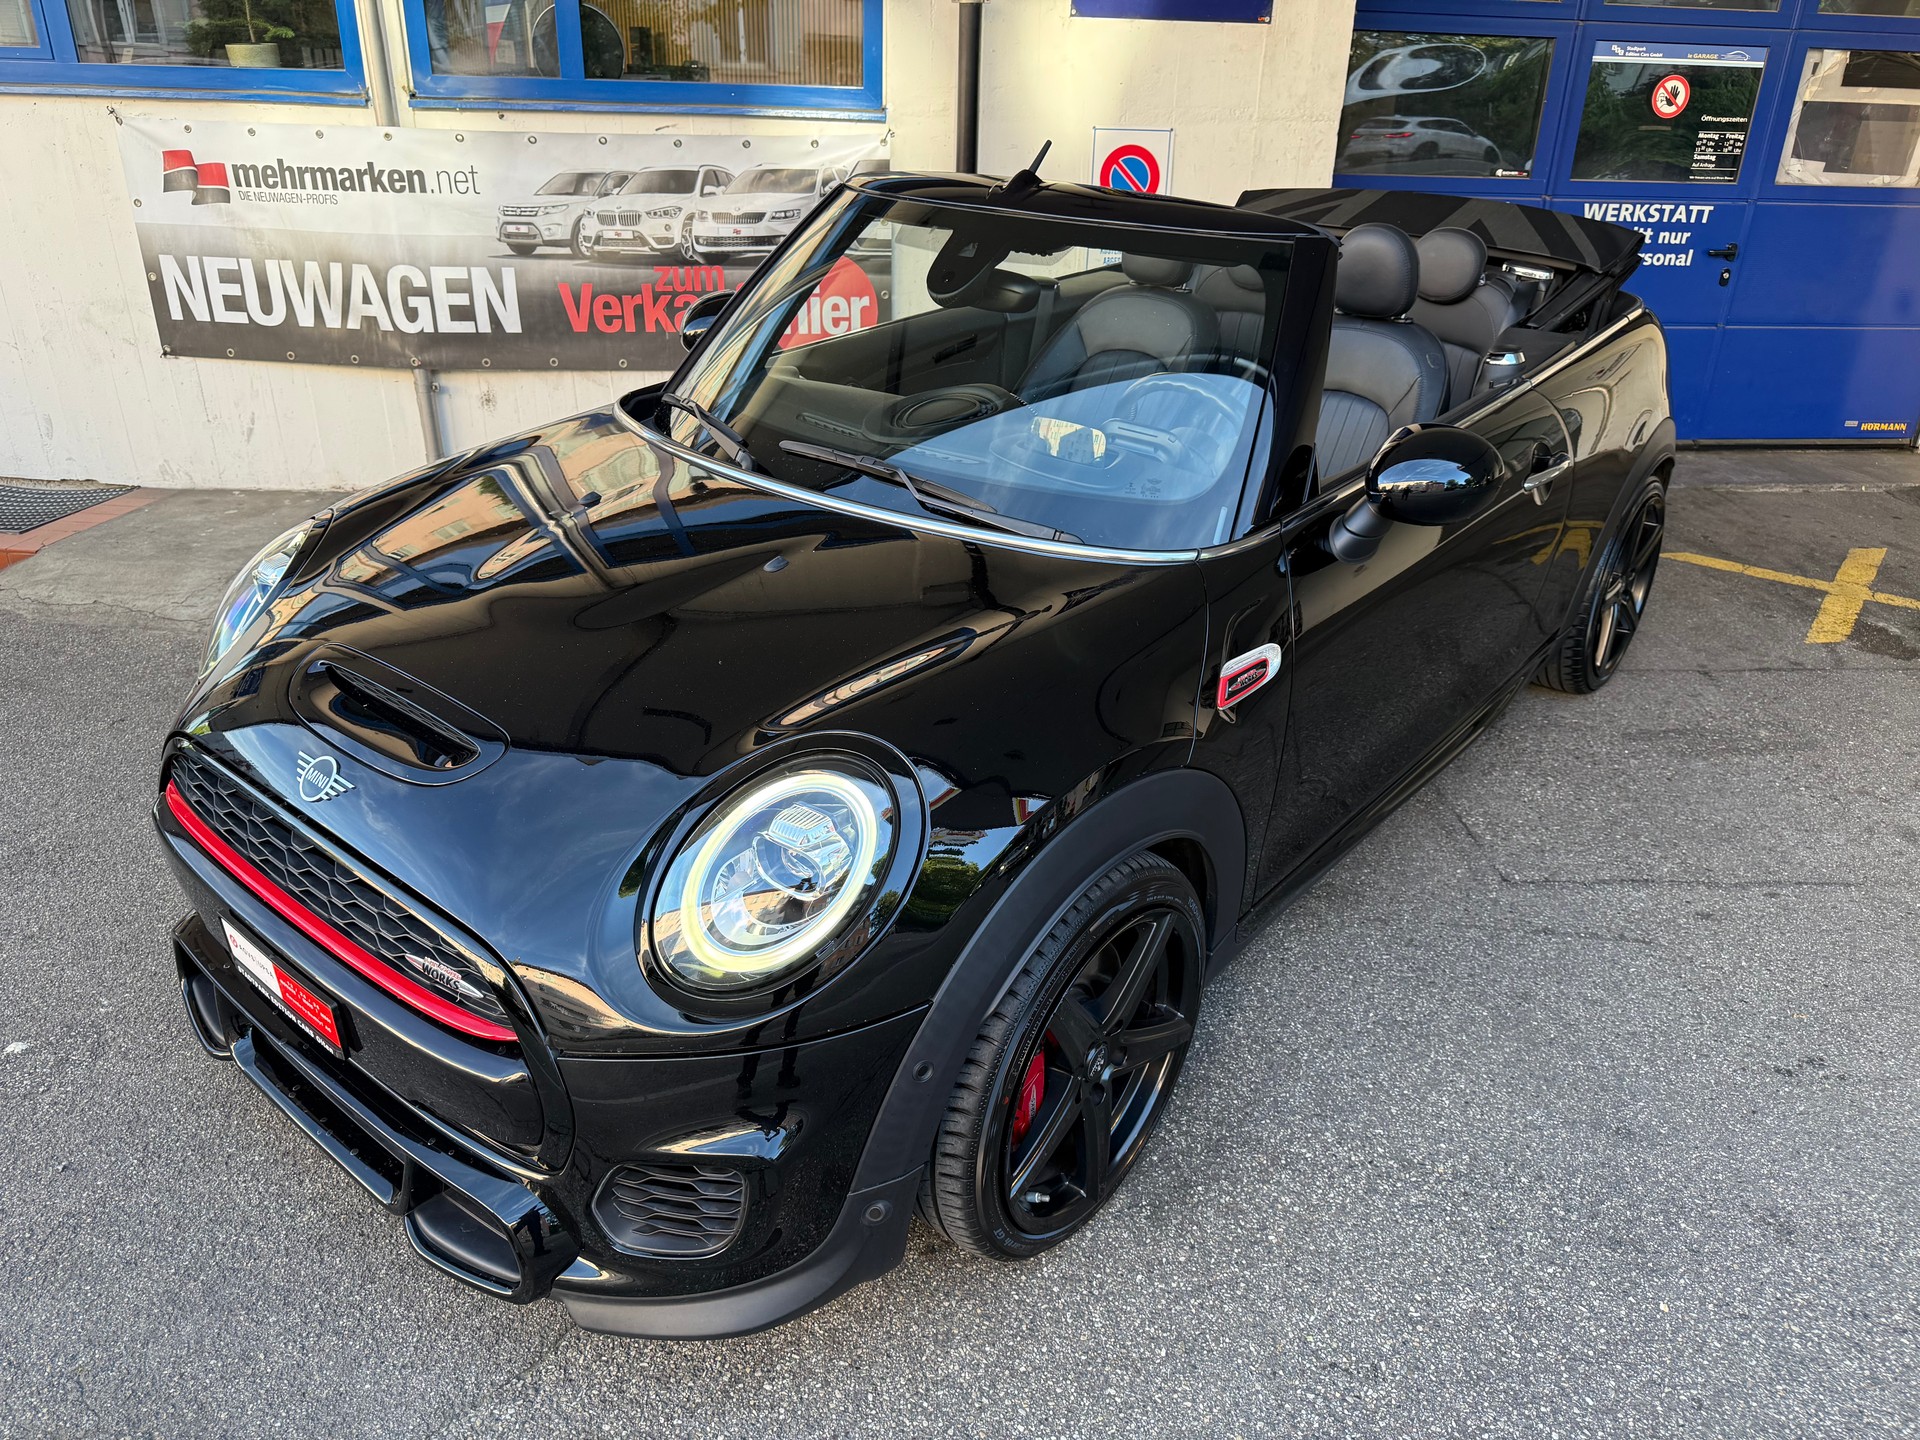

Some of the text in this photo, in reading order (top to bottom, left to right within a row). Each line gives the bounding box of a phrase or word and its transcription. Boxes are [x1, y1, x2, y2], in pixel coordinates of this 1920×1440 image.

[1725, 133, 1746, 141] Freitag
[1693, 154, 1717, 162] Samstag
[231, 158, 481, 195] mehrmarken.net
[238, 190, 339, 205] DIE NEUWAGEN-PROFIS
[1583, 203, 1715, 224] WERKSTATT
[1657, 231, 1692, 244] nur
[1637, 249, 1694, 267] sonal
[653, 265, 725, 292] zum
[158, 254, 523, 334] NEUWAGEN
[305, 767, 330, 789] MINI
[421, 962, 461, 990] WORKS
